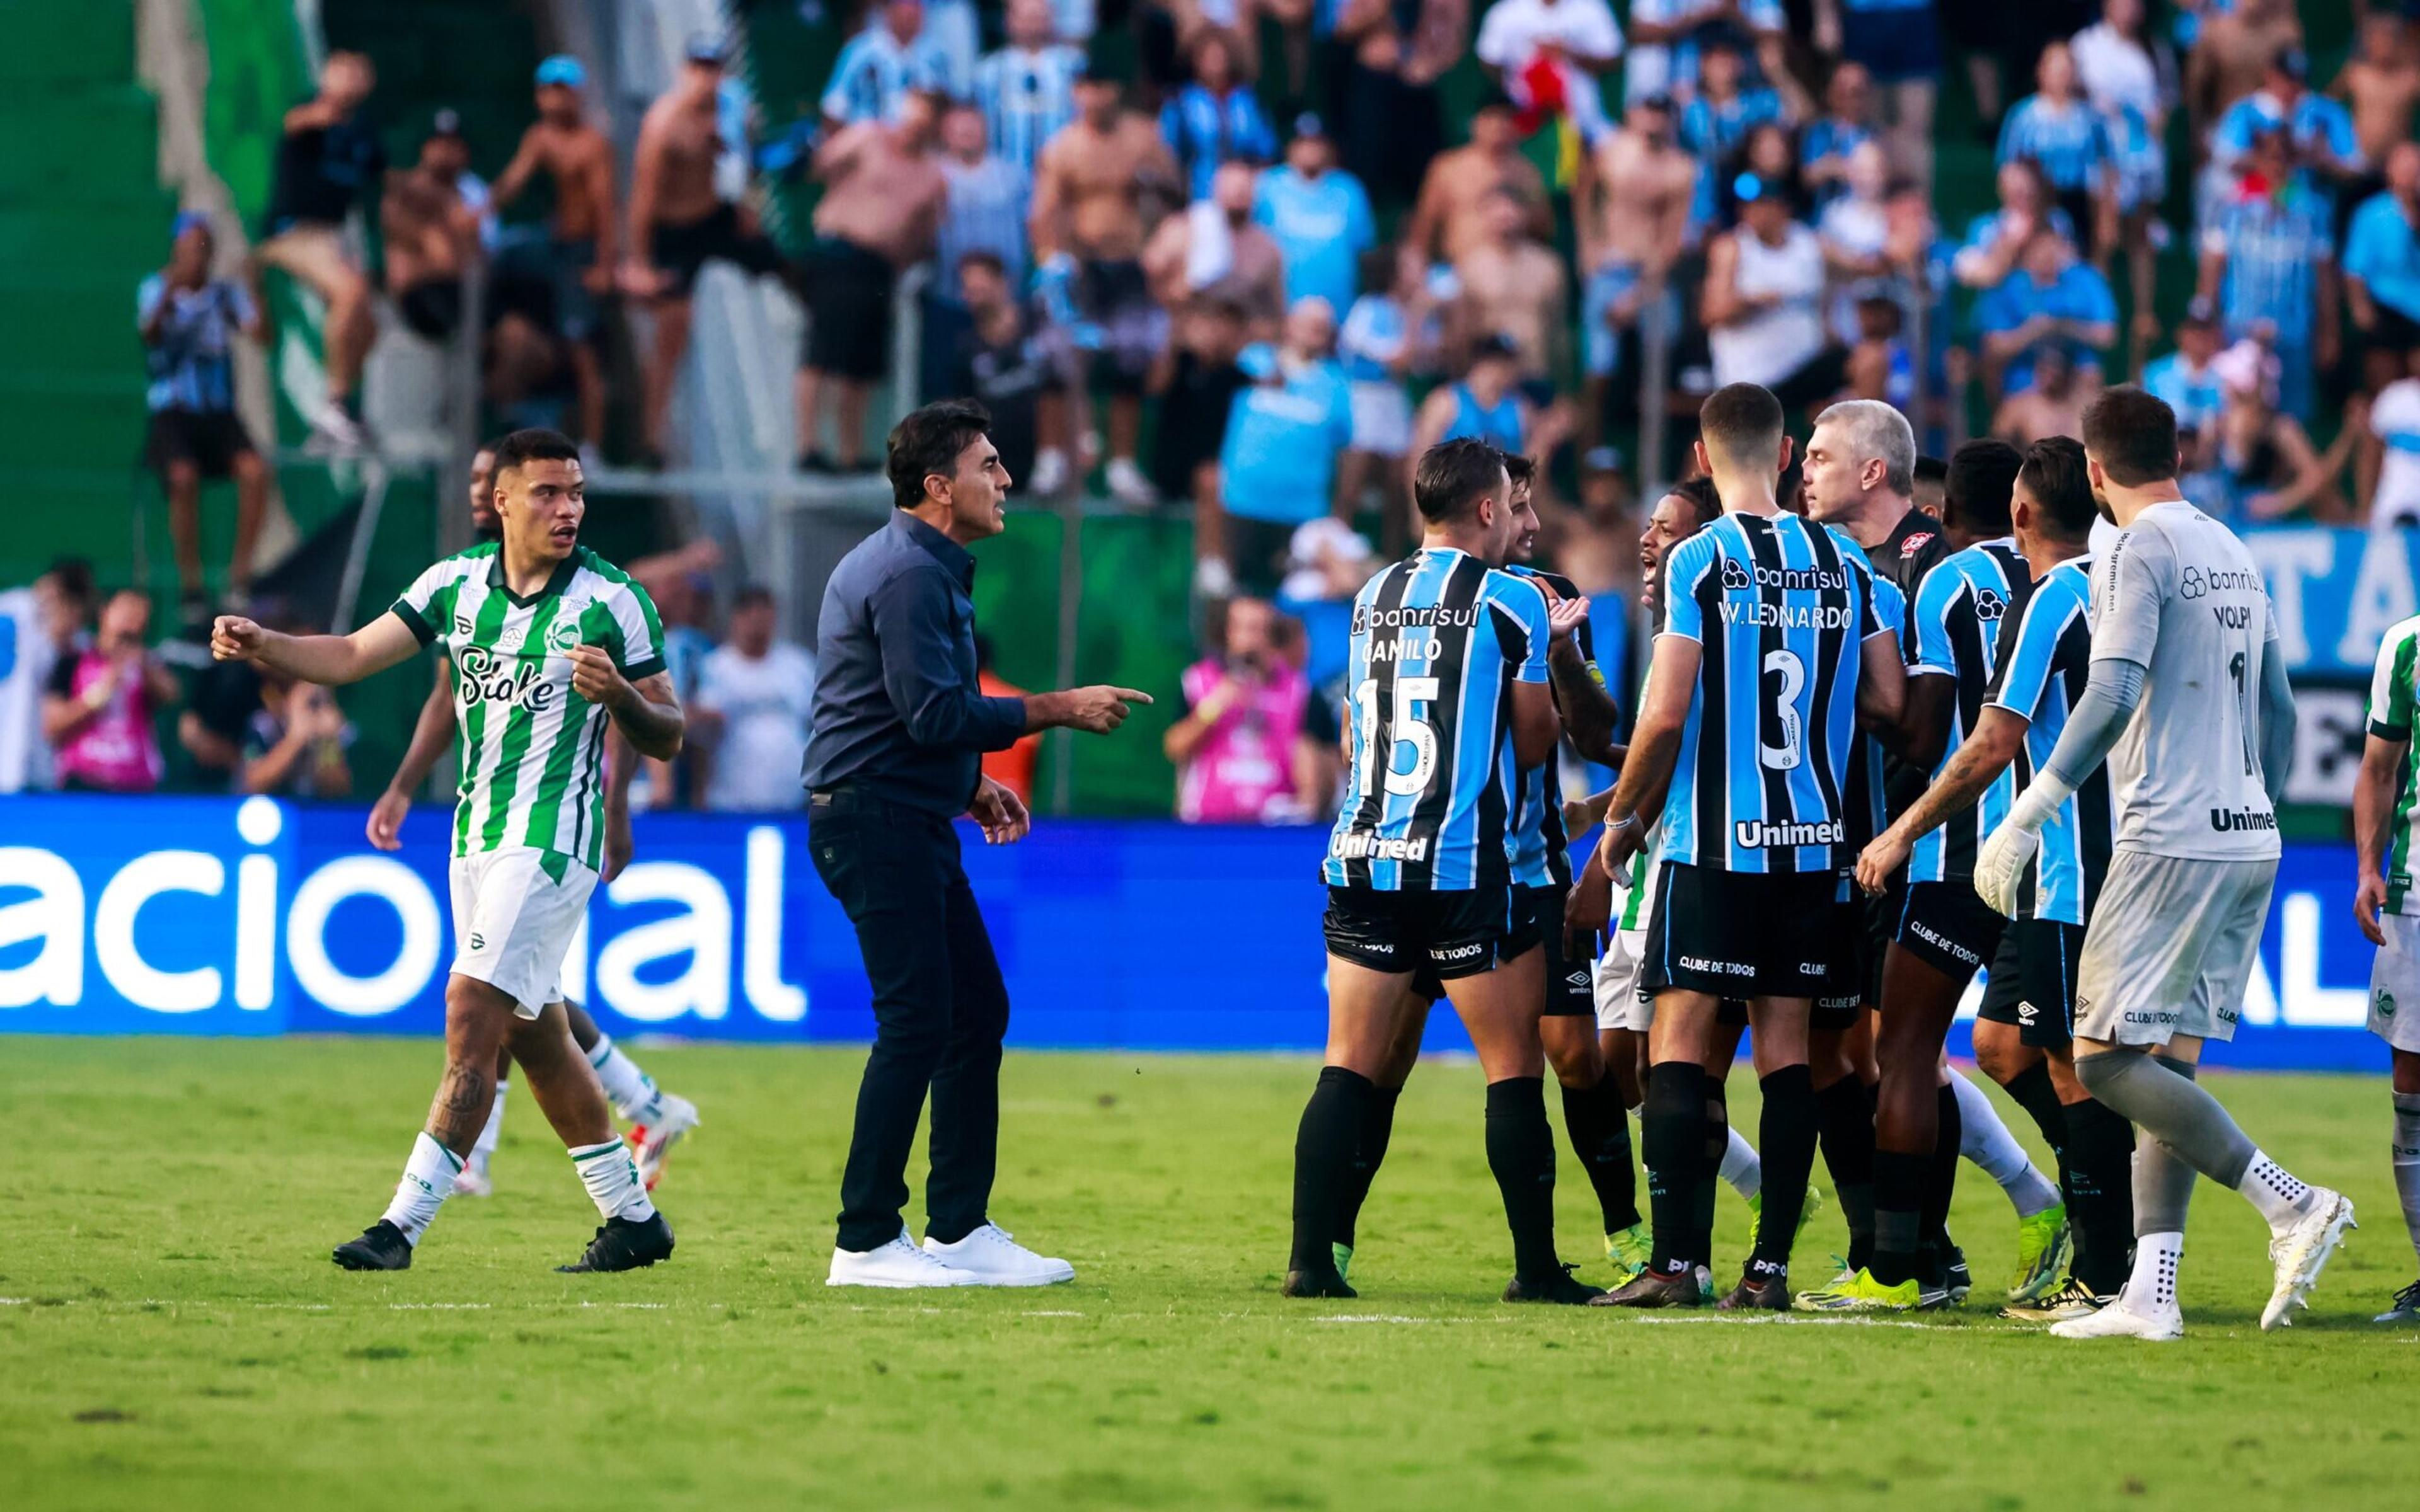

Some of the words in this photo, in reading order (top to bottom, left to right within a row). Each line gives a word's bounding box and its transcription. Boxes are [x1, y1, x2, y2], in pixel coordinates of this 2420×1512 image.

[1751, 559, 1850, 590] banrisul
[1369, 602, 1481, 629] banrisul
[1717, 602, 1853, 629] W.LEONARDO
[2213, 606, 2252, 629] VOLPI
[1362, 638, 1442, 662] CAMILO
[461, 648, 555, 711] Stake
[1761, 649, 1805, 770] 3
[2230, 651, 2253, 776] 1
[1356, 677, 1439, 796] 15
[1737, 818, 1845, 848] Unimed
[2211, 806, 2276, 832] Unime
[1331, 828, 1427, 862] Unimed
[0, 795, 808, 1021] acioal
[1446, 943, 1482, 959] TODOS
[1911, 920, 1940, 944] CLUBE
[1937, 937, 1952, 952] DE
[1951, 944, 1979, 965] TODOS
[1680, 956, 1709, 972] CLUBE
[1711, 961, 1723, 973] DE
[1726, 963, 1755, 976] TODOS
